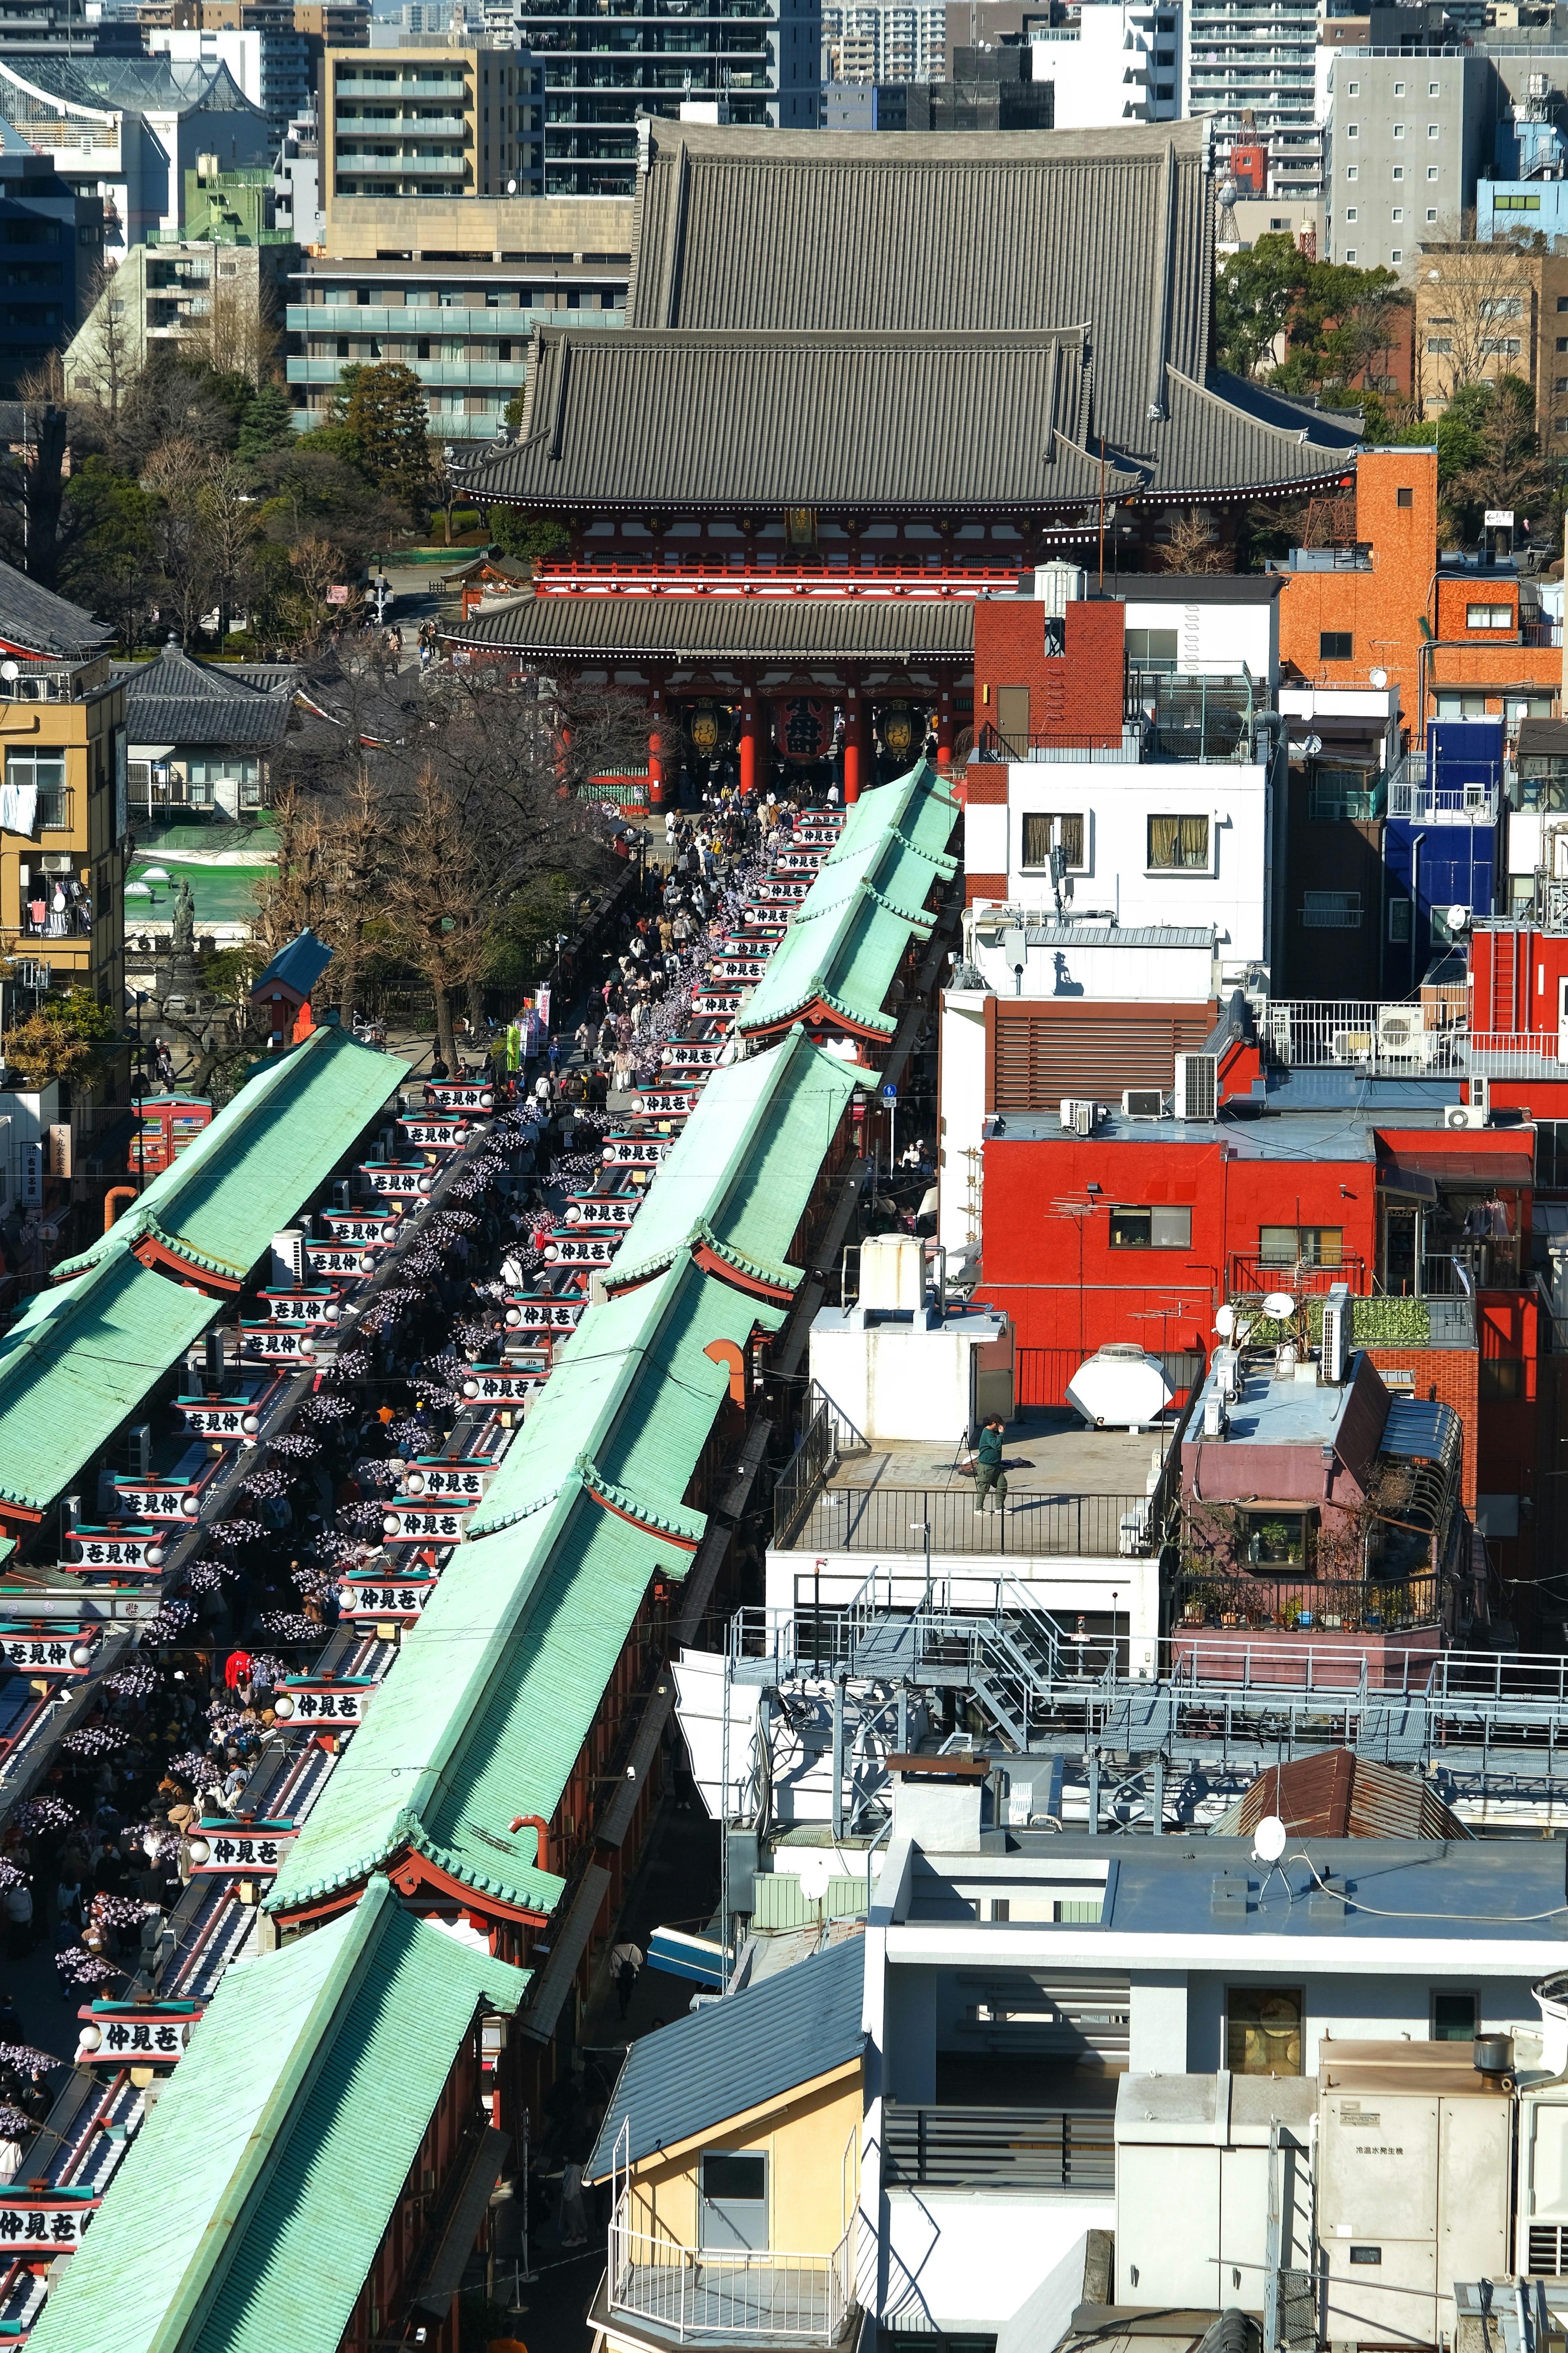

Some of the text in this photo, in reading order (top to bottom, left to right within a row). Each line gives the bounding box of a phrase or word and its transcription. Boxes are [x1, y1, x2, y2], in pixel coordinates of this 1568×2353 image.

[804, 831, 834, 841] 仲見世
[789, 856, 819, 867] 仲見世
[772, 886, 803, 897] 仲見世
[757, 910, 788, 921] 仲見世
[726, 963, 760, 976] 仲見世
[675, 1049, 711, 1063] 仲見世
[647, 1097, 685, 1110] 仲見世
[619, 1145, 658, 1160] 仲見世
[584, 1205, 626, 1220] 仲見世
[561, 1243, 605, 1259] 仲見世
[524, 1307, 570, 1324] 仲見世
[428, 1474, 479, 1492] 仲見世
[404, 1515, 457, 1534] 仲見世
[361, 1590, 416, 1609] 仲見世
[298, 1695, 356, 1717] 仲見世
[214, 1840, 277, 1863] 仲見世
[107, 2024, 178, 2050] 仲見世
[1356, 2146, 1403, 2155] 冷温水発生機
[0, 2211, 75, 2240] 仲見世
